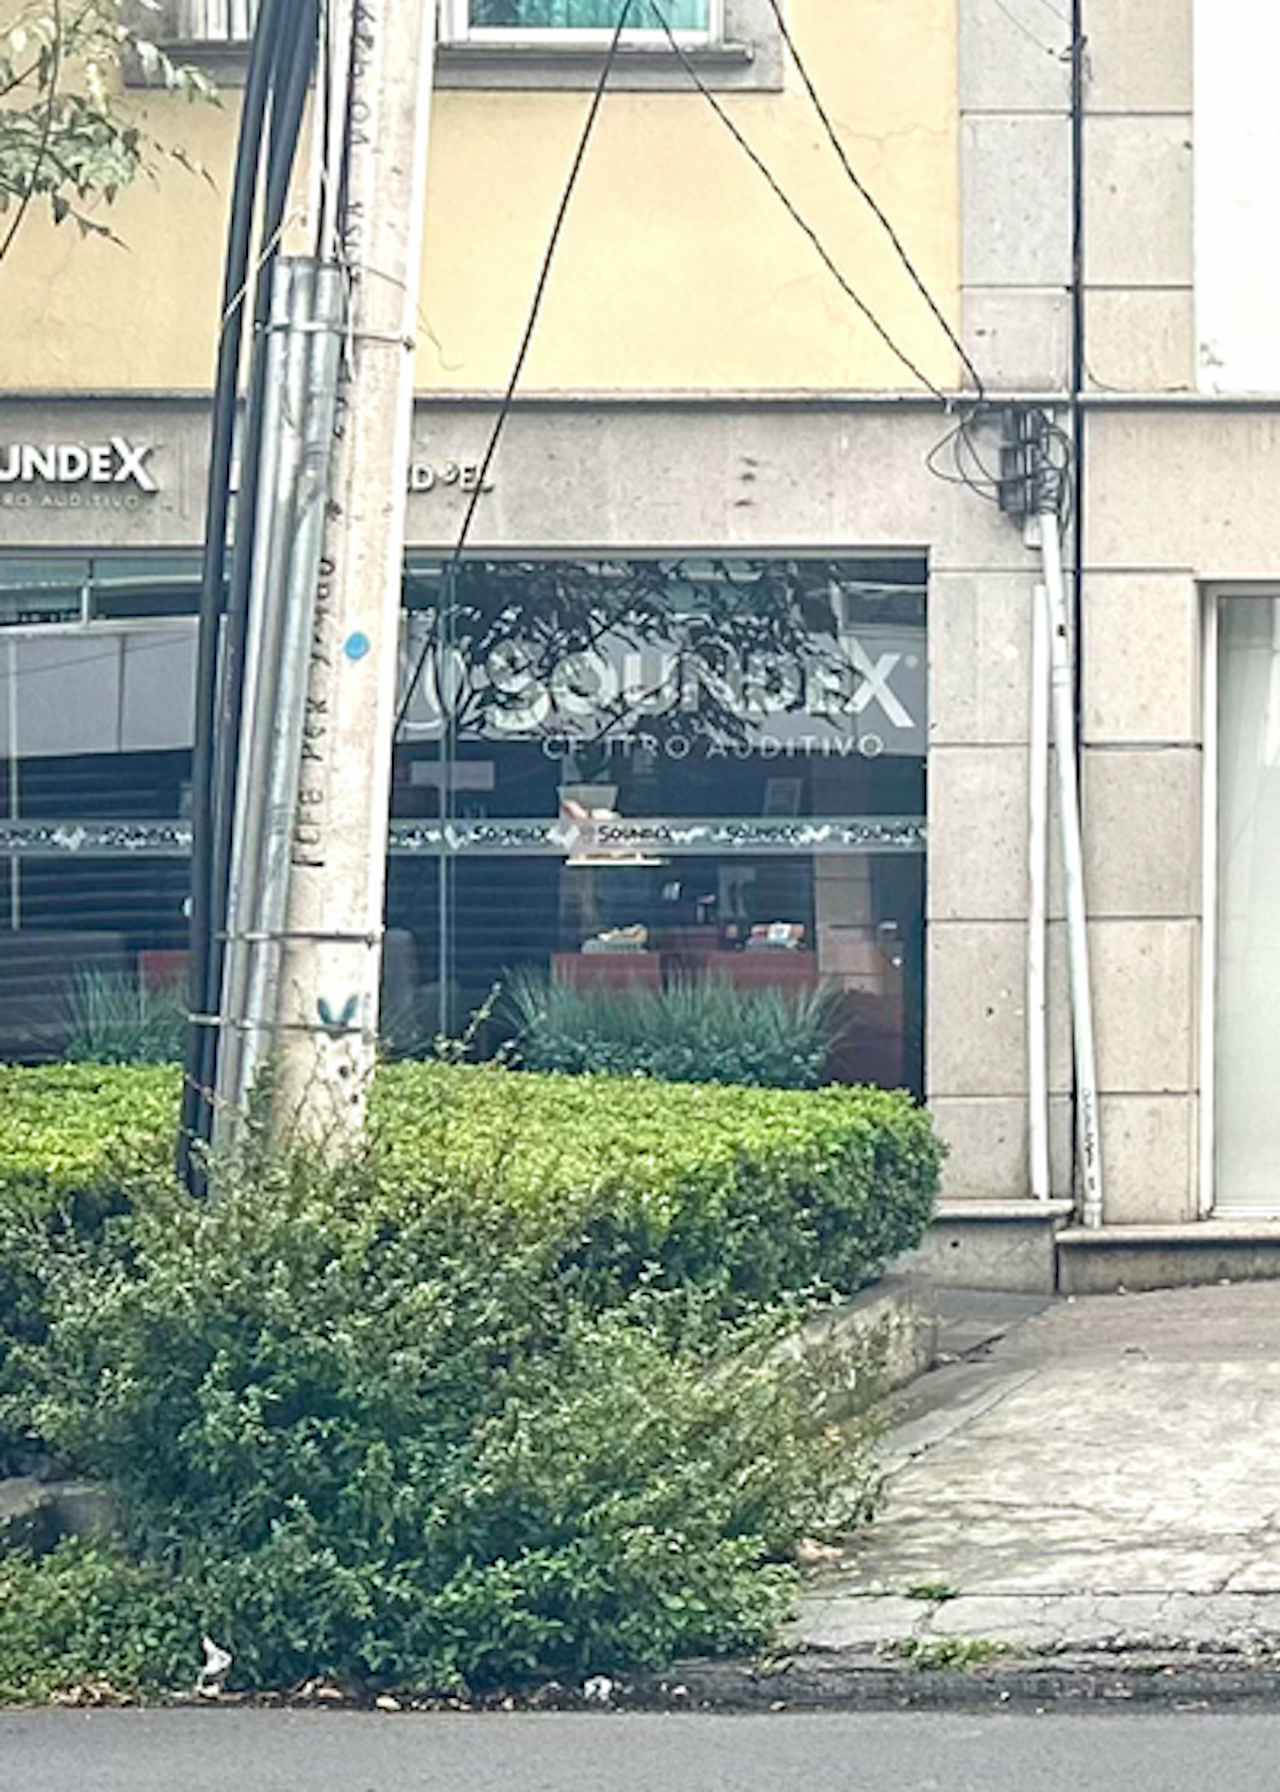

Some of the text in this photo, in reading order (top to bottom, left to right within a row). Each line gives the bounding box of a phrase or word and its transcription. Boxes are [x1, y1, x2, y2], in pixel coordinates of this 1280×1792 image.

[485, 637, 914, 729] SOUNDEX
[542, 734, 885, 761] CENTRO AUDITIVO
